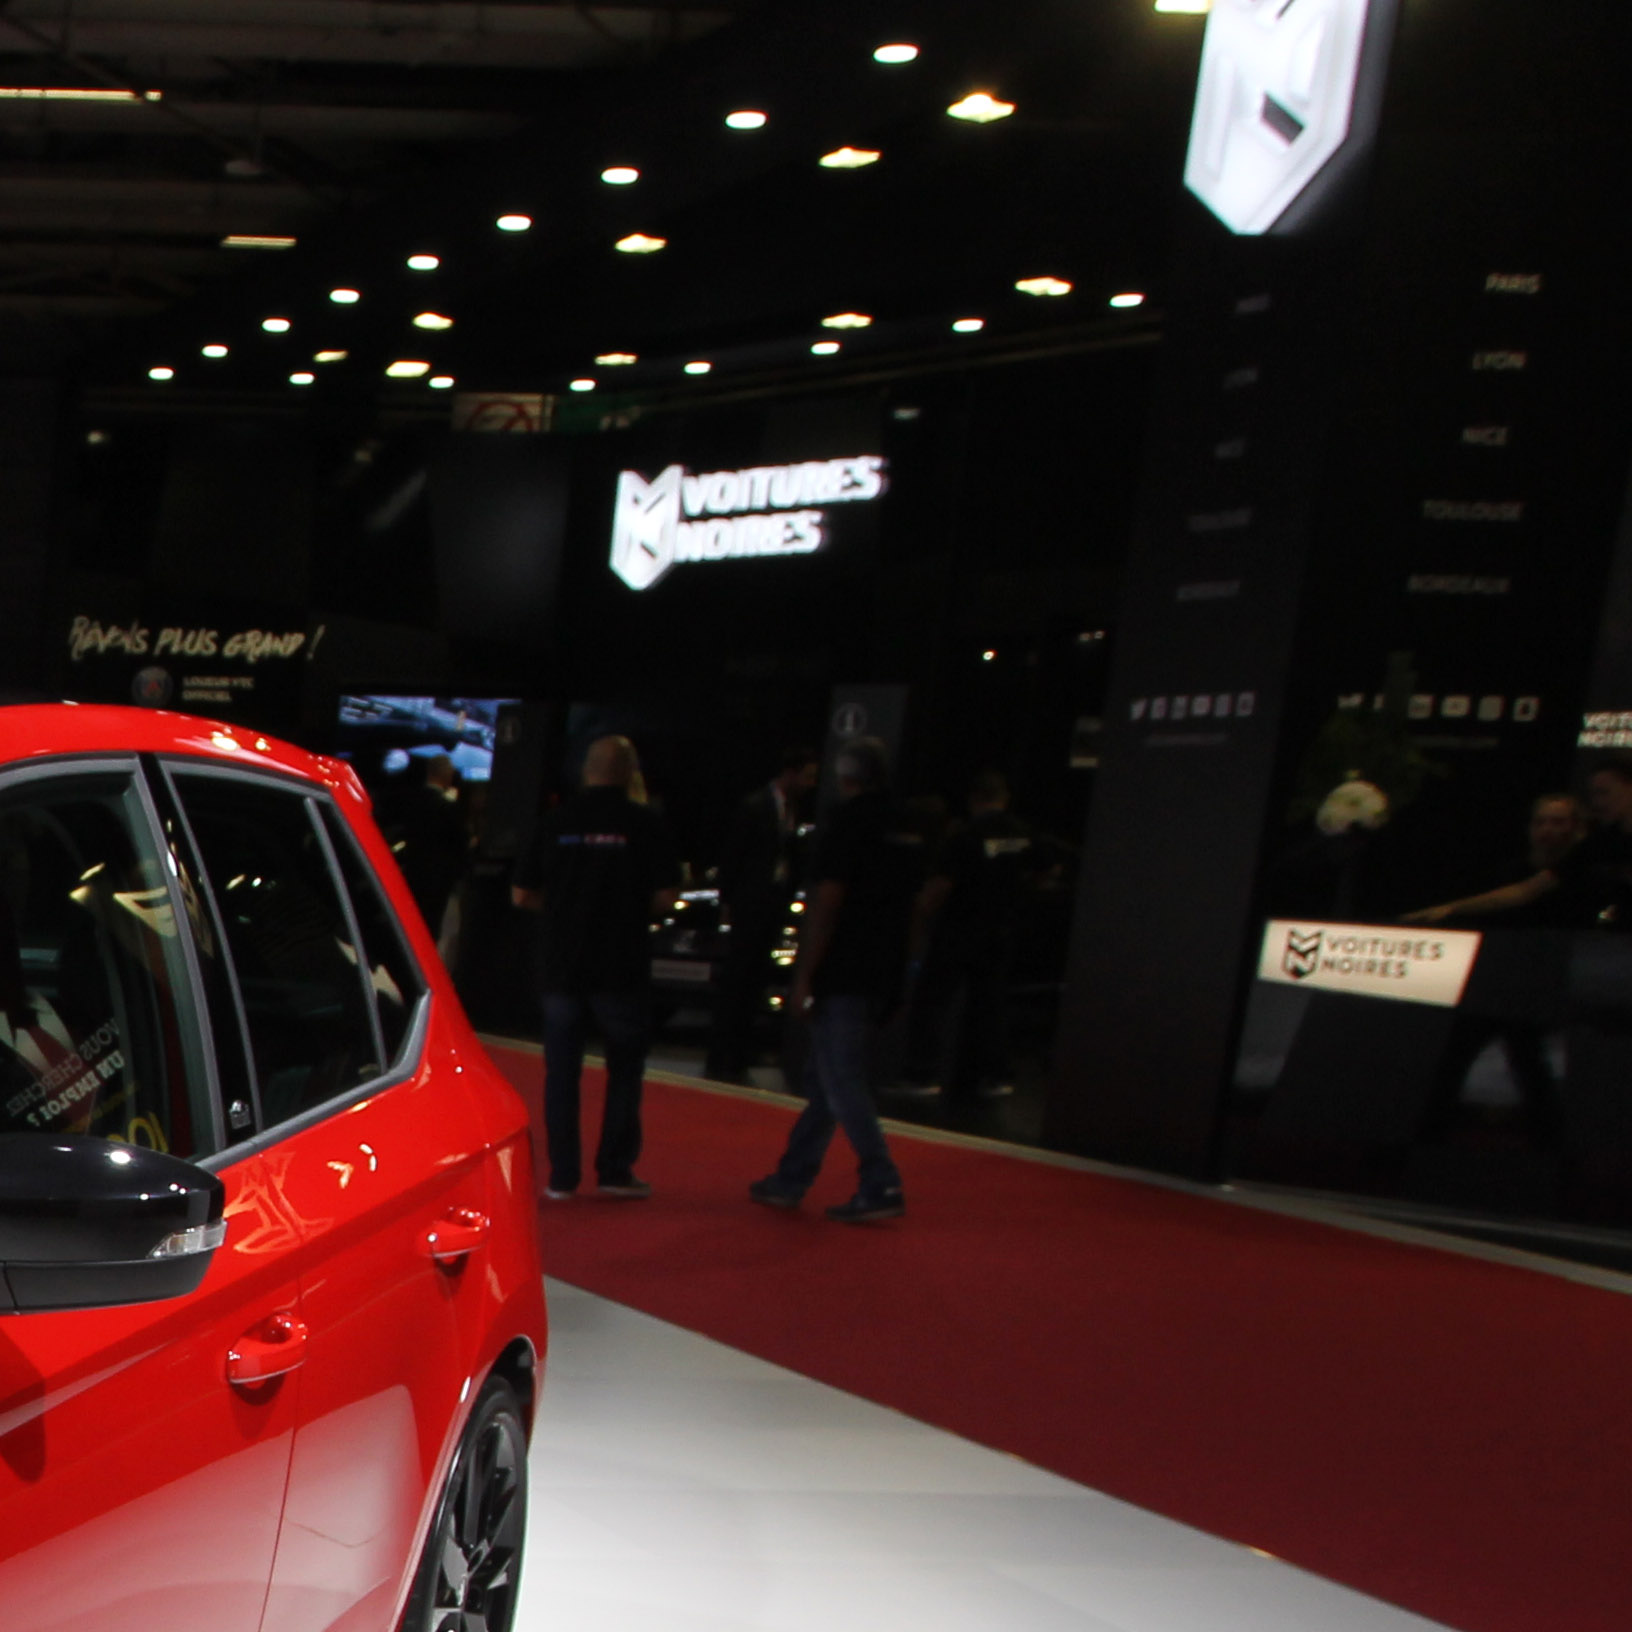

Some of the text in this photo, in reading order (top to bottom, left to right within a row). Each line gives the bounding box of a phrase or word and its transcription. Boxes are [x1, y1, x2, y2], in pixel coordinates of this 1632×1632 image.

[1485, 273, 1541, 294] PARIS
[1471, 351, 1527, 370] LYON
[683, 455, 886, 517] VOITURES
[674, 509, 824, 563] NOIRES
[154, 626, 220, 658] PLUS
[223, 627, 306, 664] GRAND
[1324, 936, 1446, 961] VOITURES
[1320, 957, 1409, 979] NOIRES
